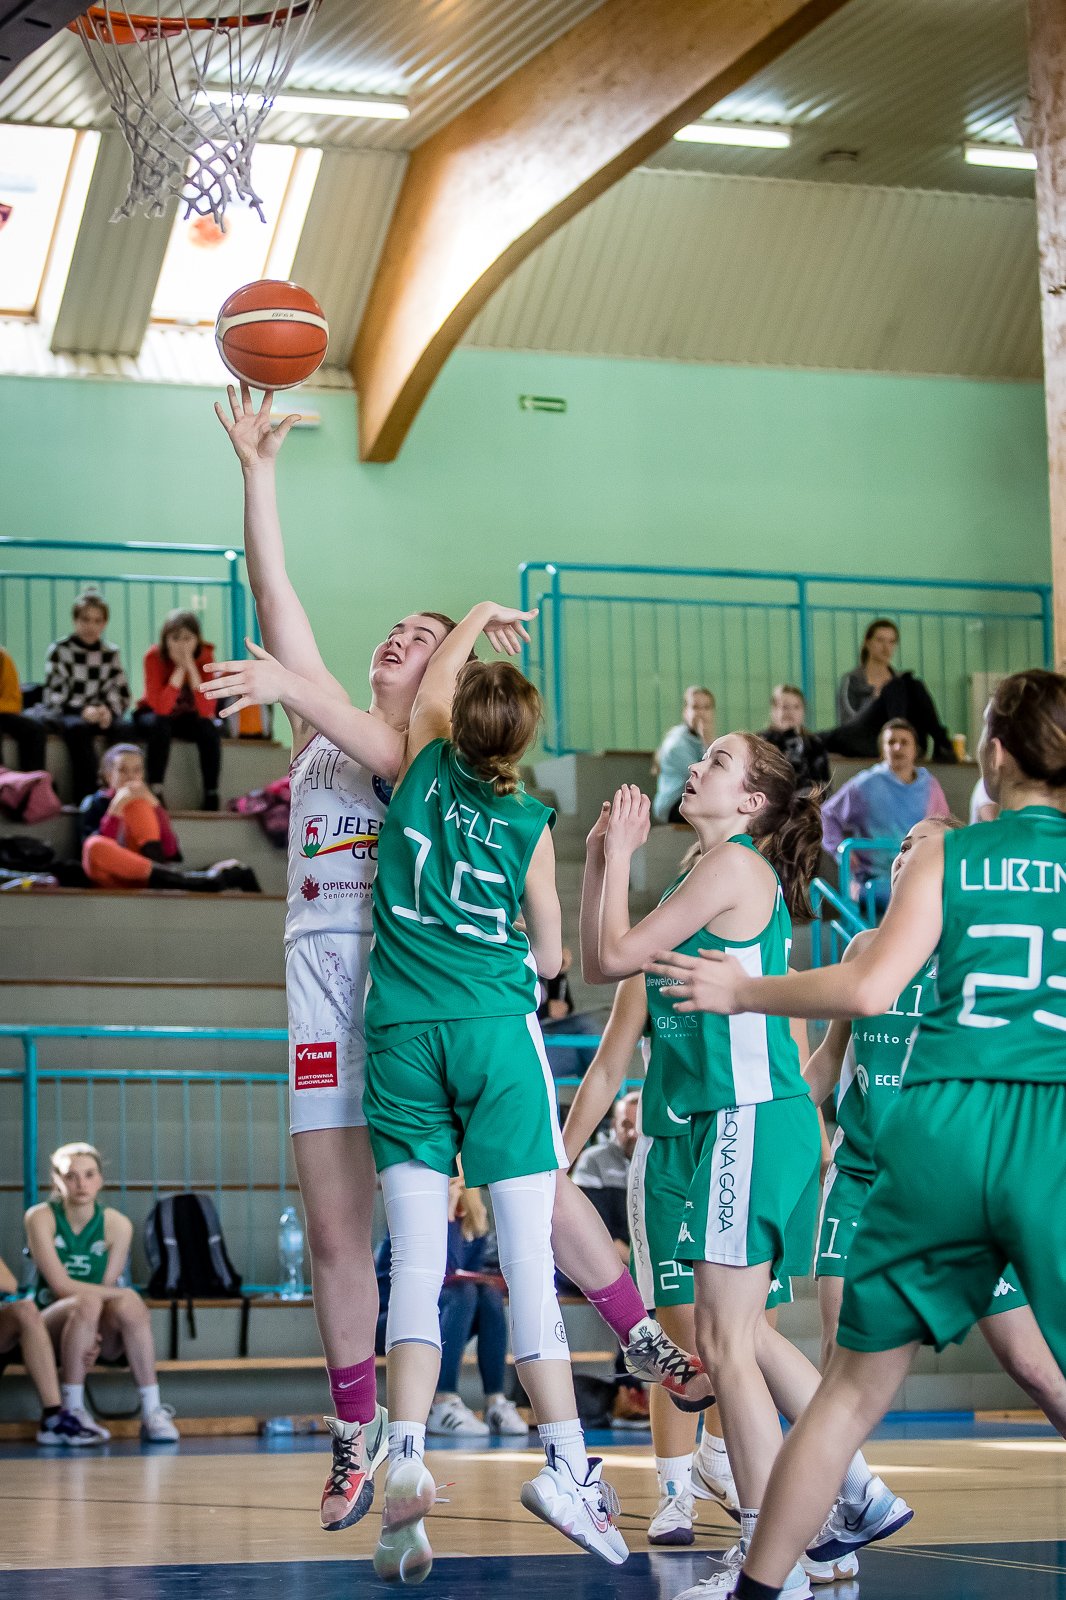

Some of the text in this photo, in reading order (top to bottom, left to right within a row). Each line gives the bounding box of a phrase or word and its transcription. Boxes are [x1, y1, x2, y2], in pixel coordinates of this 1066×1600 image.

[304, 748, 341, 790] 41
[333, 815, 384, 837] JELE
[391, 826, 508, 944] 15
[863, 1031, 900, 1044] fatto
[719, 1106, 739, 1169] LONA
